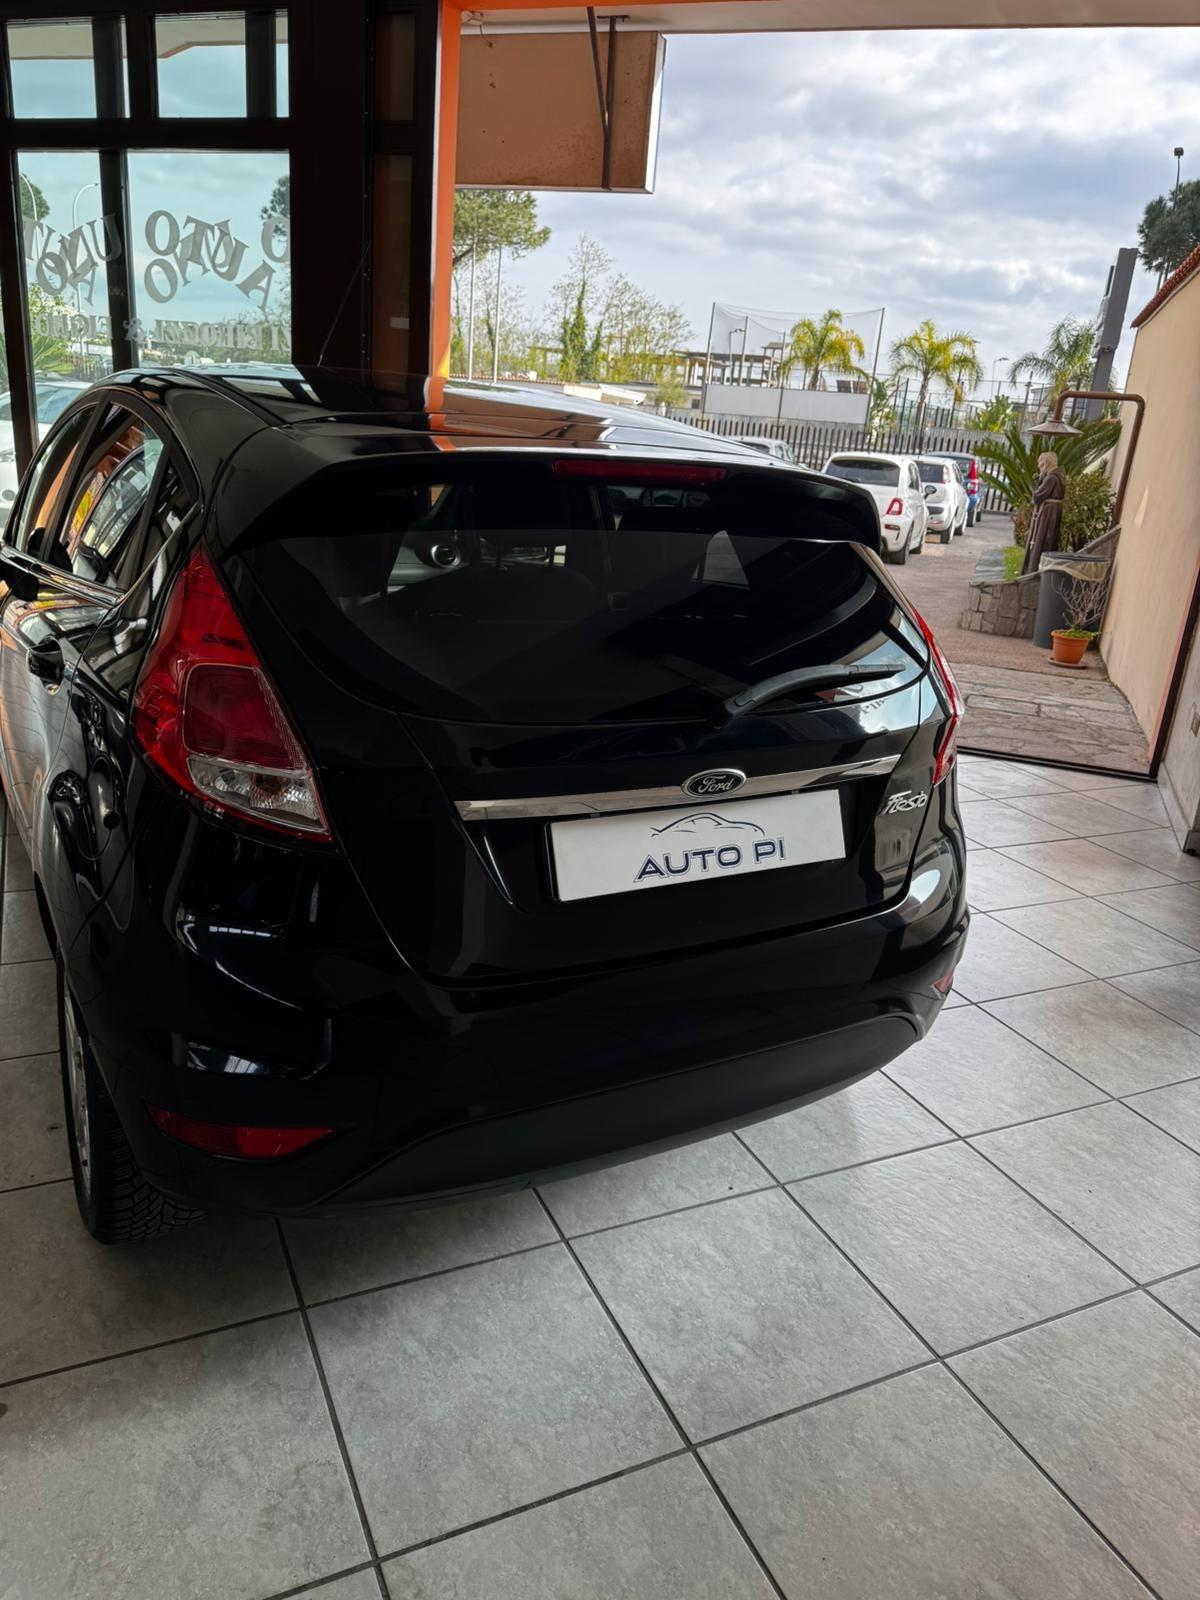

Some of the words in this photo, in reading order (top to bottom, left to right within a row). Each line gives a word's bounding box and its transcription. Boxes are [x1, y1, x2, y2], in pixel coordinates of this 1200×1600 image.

[697, 775, 733, 793] Ford
[882, 790, 928, 815] Fiesta
[633, 844, 742, 883] AUTO
[753, 837, 787, 865] PI
